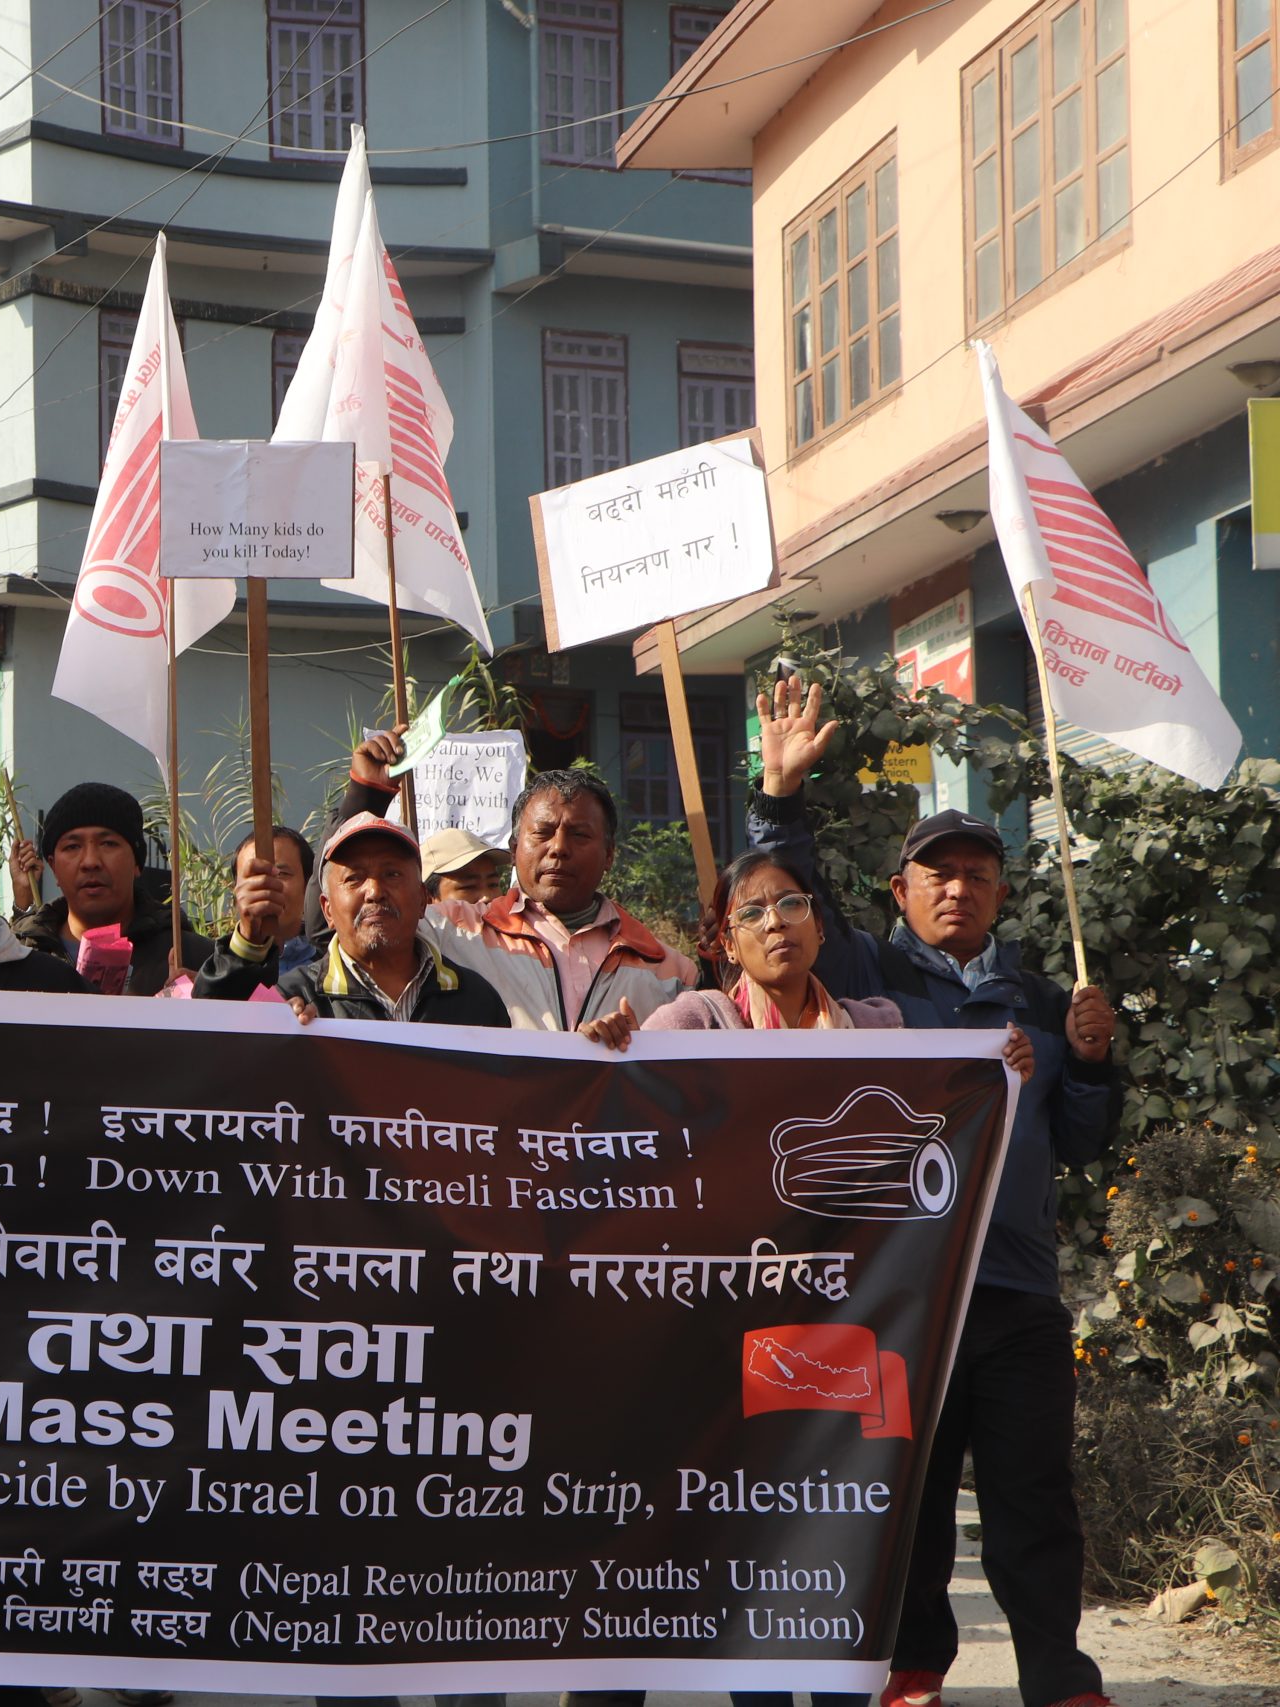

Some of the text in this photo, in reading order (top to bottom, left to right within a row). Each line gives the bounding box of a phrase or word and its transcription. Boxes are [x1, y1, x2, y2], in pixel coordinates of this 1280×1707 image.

[190, 522, 324, 539] How Many kids do
[682, 535, 714, 559] गर
[203, 545, 310, 562] you kill Today!
[1041, 619, 1184, 696] किसान पार्टीको
[425, 764, 469, 783] Hide,
[476, 766, 503, 783] We
[475, 745, 506, 761] you
[435, 793, 467, 809] you
[473, 791, 509, 809] with
[101, 1102, 304, 1143] इजरायली
[329, 1108, 498, 1155] फासीवाद
[518, 1122, 659, 1171] मुर्दावाद
[86, 1158, 221, 1193] Down
[239, 1163, 347, 1198] With
[365, 1168, 492, 1206] Israeli
[506, 1177, 677, 1209] Fascism
[155, 1225, 265, 1291] बर्बर
[294, 1245, 425, 1300] हमला
[453, 1251, 543, 1296] तथा
[569, 1238, 854, 1308] नरसंहारविरुद्ध
[28, 1311, 212, 1375] तथा
[243, 1320, 434, 1384] सभा
[208, 1390, 532, 1471] Meeting
[107, 1464, 166, 1523] by
[186, 1468, 319, 1515] Israel
[340, 1486, 397, 1516] on
[417, 1474, 525, 1517] Gaza
[544, 1471, 654, 1525] Strip,
[677, 1469, 890, 1513] Palestine
[63, 1560, 120, 1597] युवा
[138, 1562, 217, 1599] सङ्घ
[240, 1562, 350, 1603] (Nepal
[364, 1563, 577, 1599] Revolutionary
[728, 1560, 845, 1598] Union)
[4, 1595, 114, 1634] विद्यार्थी
[131, 1610, 211, 1646] सङ्घ
[230, 1611, 341, 1651] (Nepal
[355, 1609, 569, 1647] Revolutionary
[745, 1608, 864, 1646] Union)
